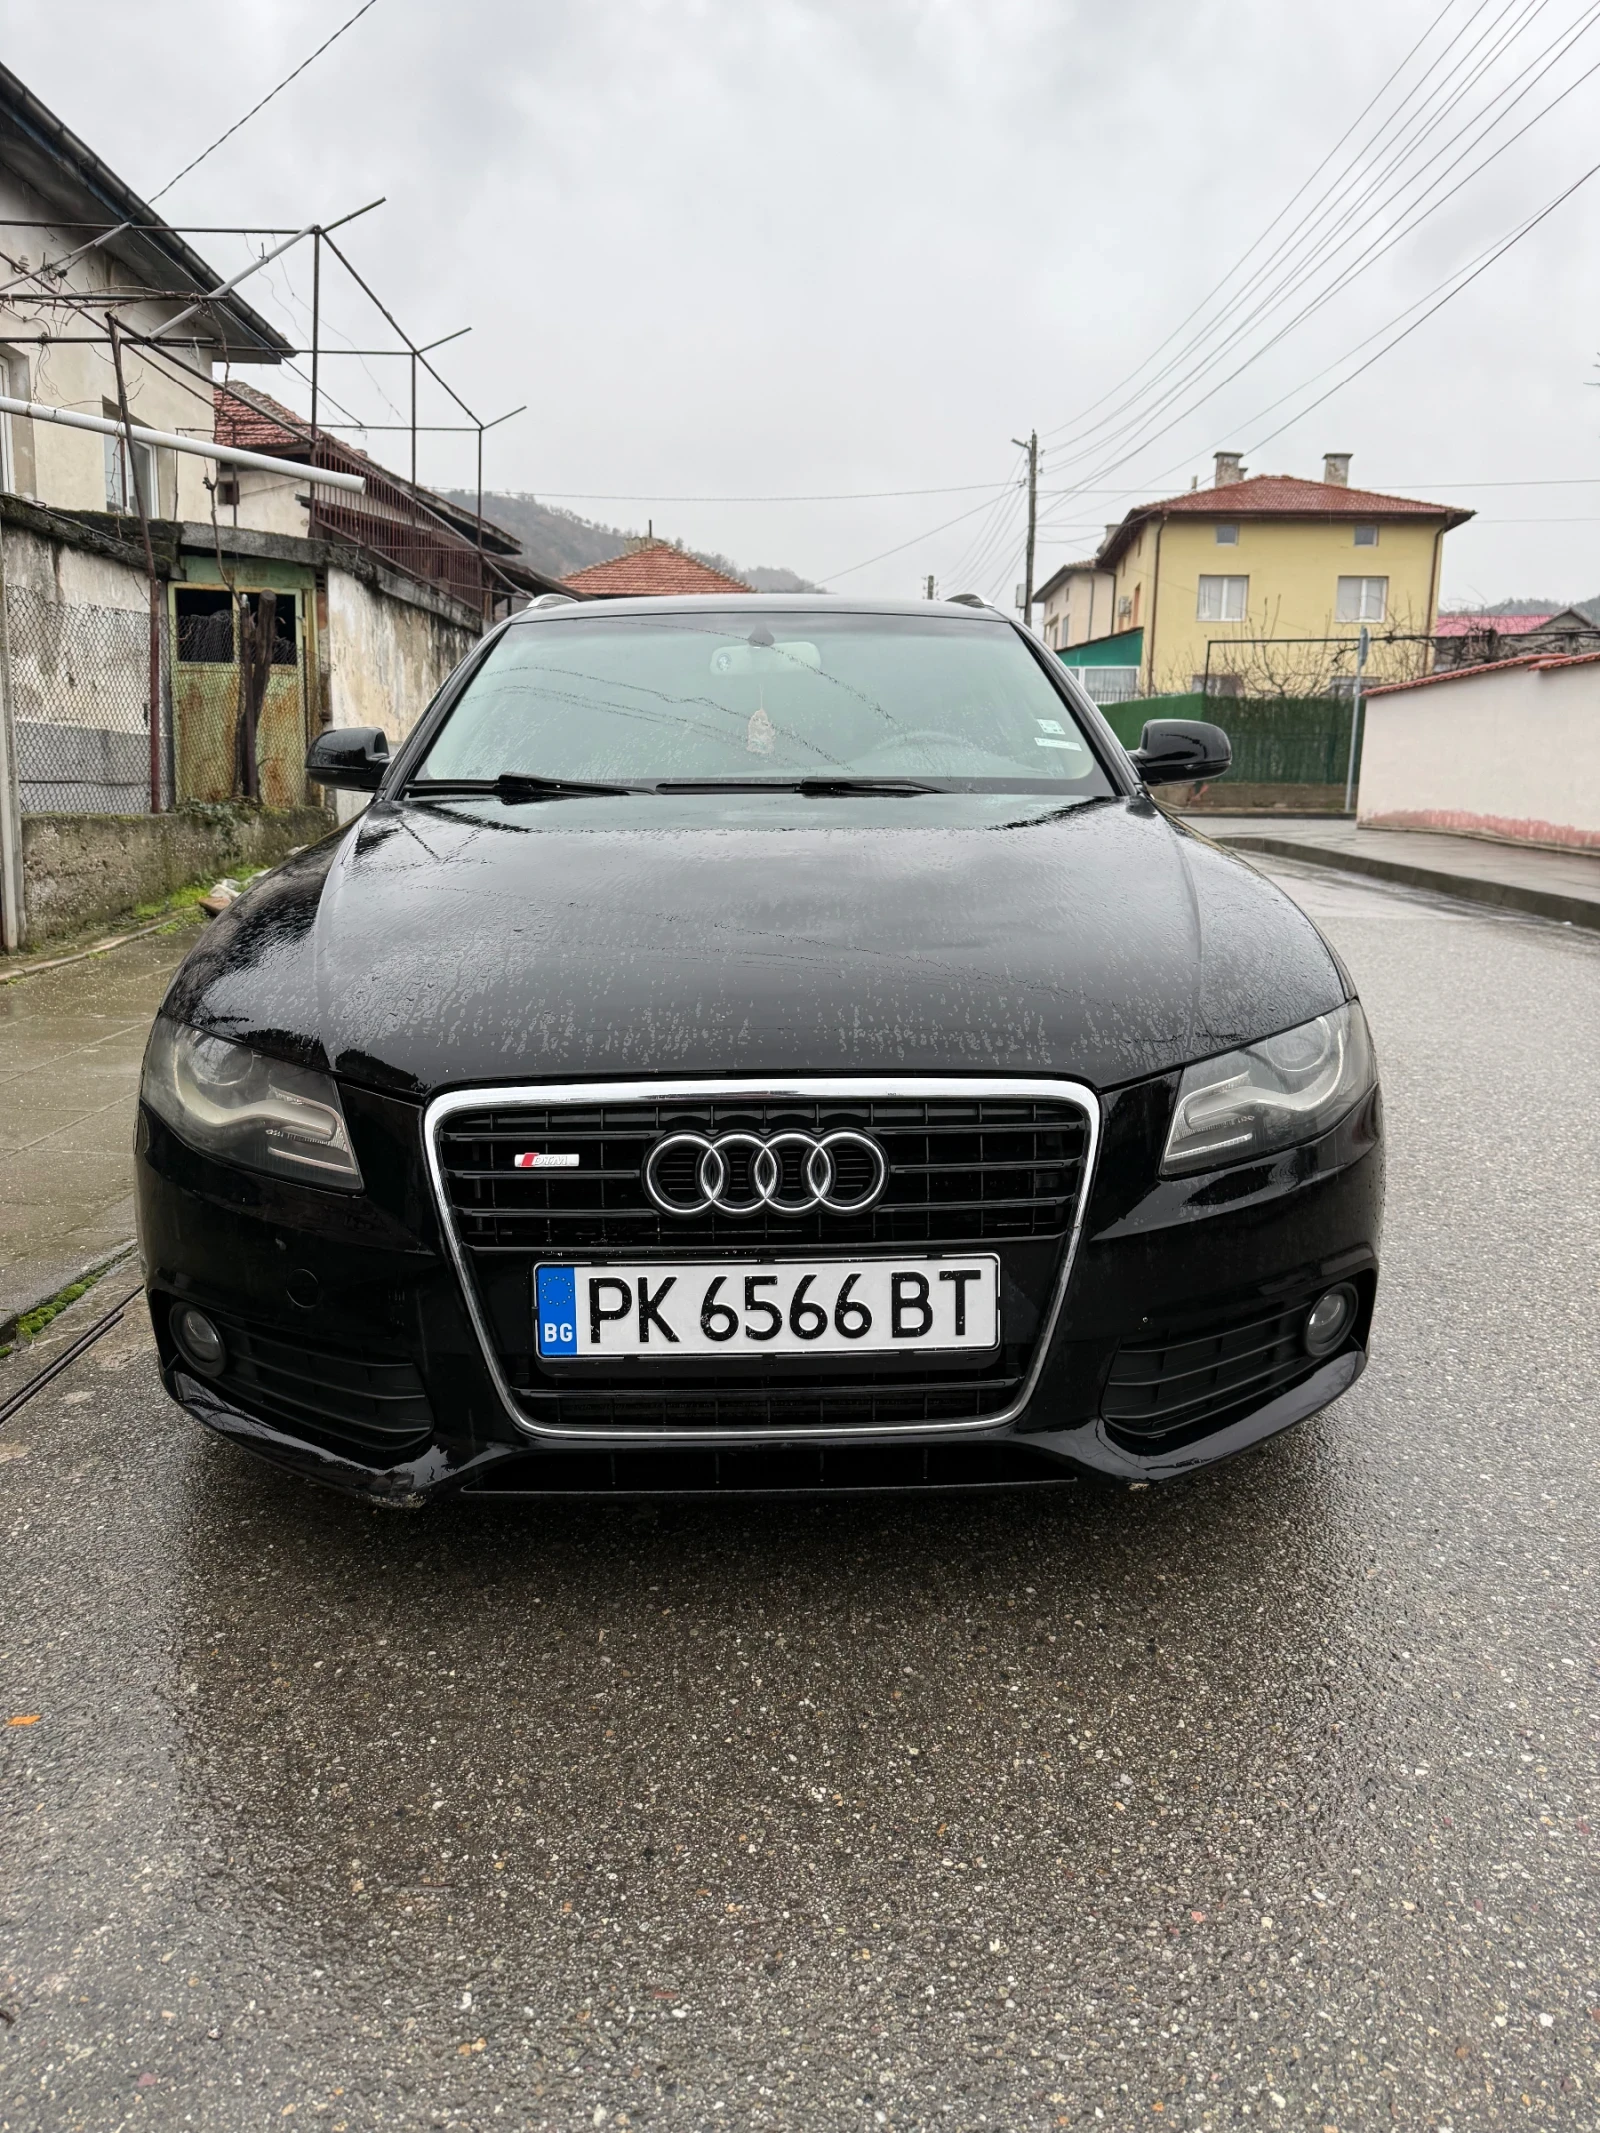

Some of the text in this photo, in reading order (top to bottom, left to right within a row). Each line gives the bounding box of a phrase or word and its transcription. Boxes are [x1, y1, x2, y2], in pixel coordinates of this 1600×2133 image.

[588, 1269, 982, 1344] PK 6566 BT
[543, 1323, 573, 1343] BG
